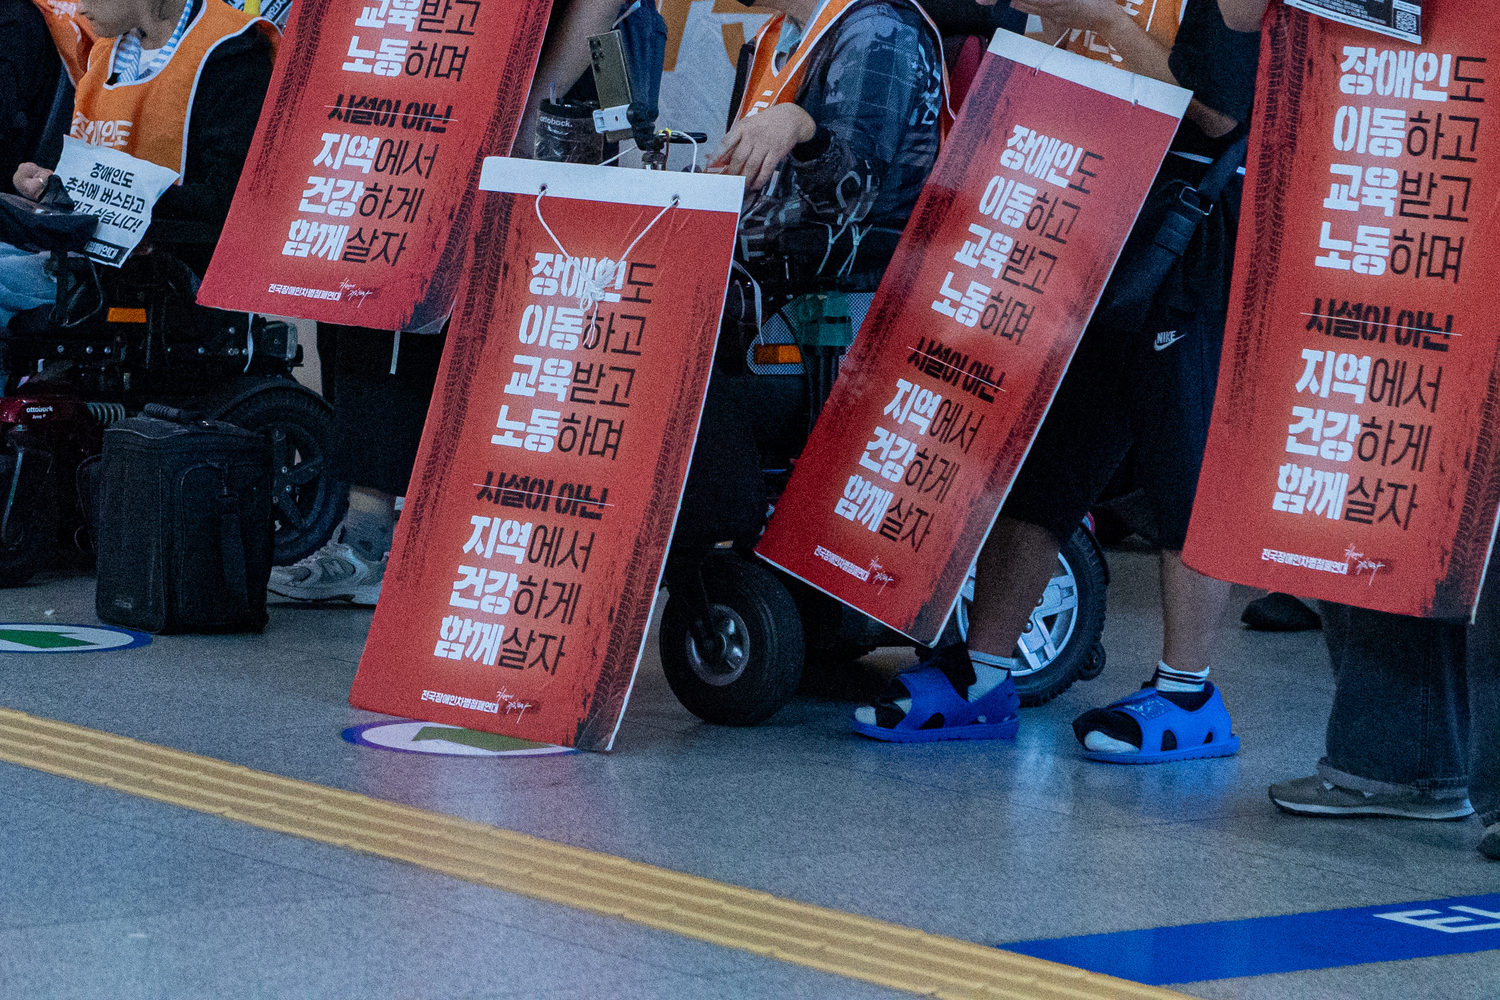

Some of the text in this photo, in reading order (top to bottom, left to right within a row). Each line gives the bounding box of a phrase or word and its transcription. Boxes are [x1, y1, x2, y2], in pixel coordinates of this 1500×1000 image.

[341, 35, 468, 82] 노동하며
[1339, 44, 1488, 104] 장애인도
[328, 92, 401, 129] 시설이
[1332, 104, 1482, 164] 이동하고
[90, 162, 135, 189] 장애인도
[313, 131, 438, 179] 지역에서
[1000, 123, 1104, 196] 장애인도
[65, 177, 145, 215] 추석에 버스타고
[297, 176, 425, 225] 건강하게
[979, 174, 1081, 245] 이동하고
[1323, 163, 1474, 224] 교육받고
[953, 224, 1059, 297] 교육받고
[1315, 220, 1465, 283] 노동하며
[519, 306, 647, 357] 이동하고
[931, 272, 1035, 347] 노동하며
[1156, 330, 1176, 345] NIKE
[1304, 297, 1392, 344] 시설이
[504, 354, 634, 410] 교육받고
[1295, 347, 1444, 415] 지역에서
[490, 403, 625, 461] 노동하며
[884, 378, 984, 454] 지역에서
[1286, 405, 1432, 473] 건강하게
[476, 471, 553, 514] 시설이
[864, 426, 960, 502] 건강하게
[462, 515, 594, 573] 지역에서
[449, 565, 582, 624] 건강하게
